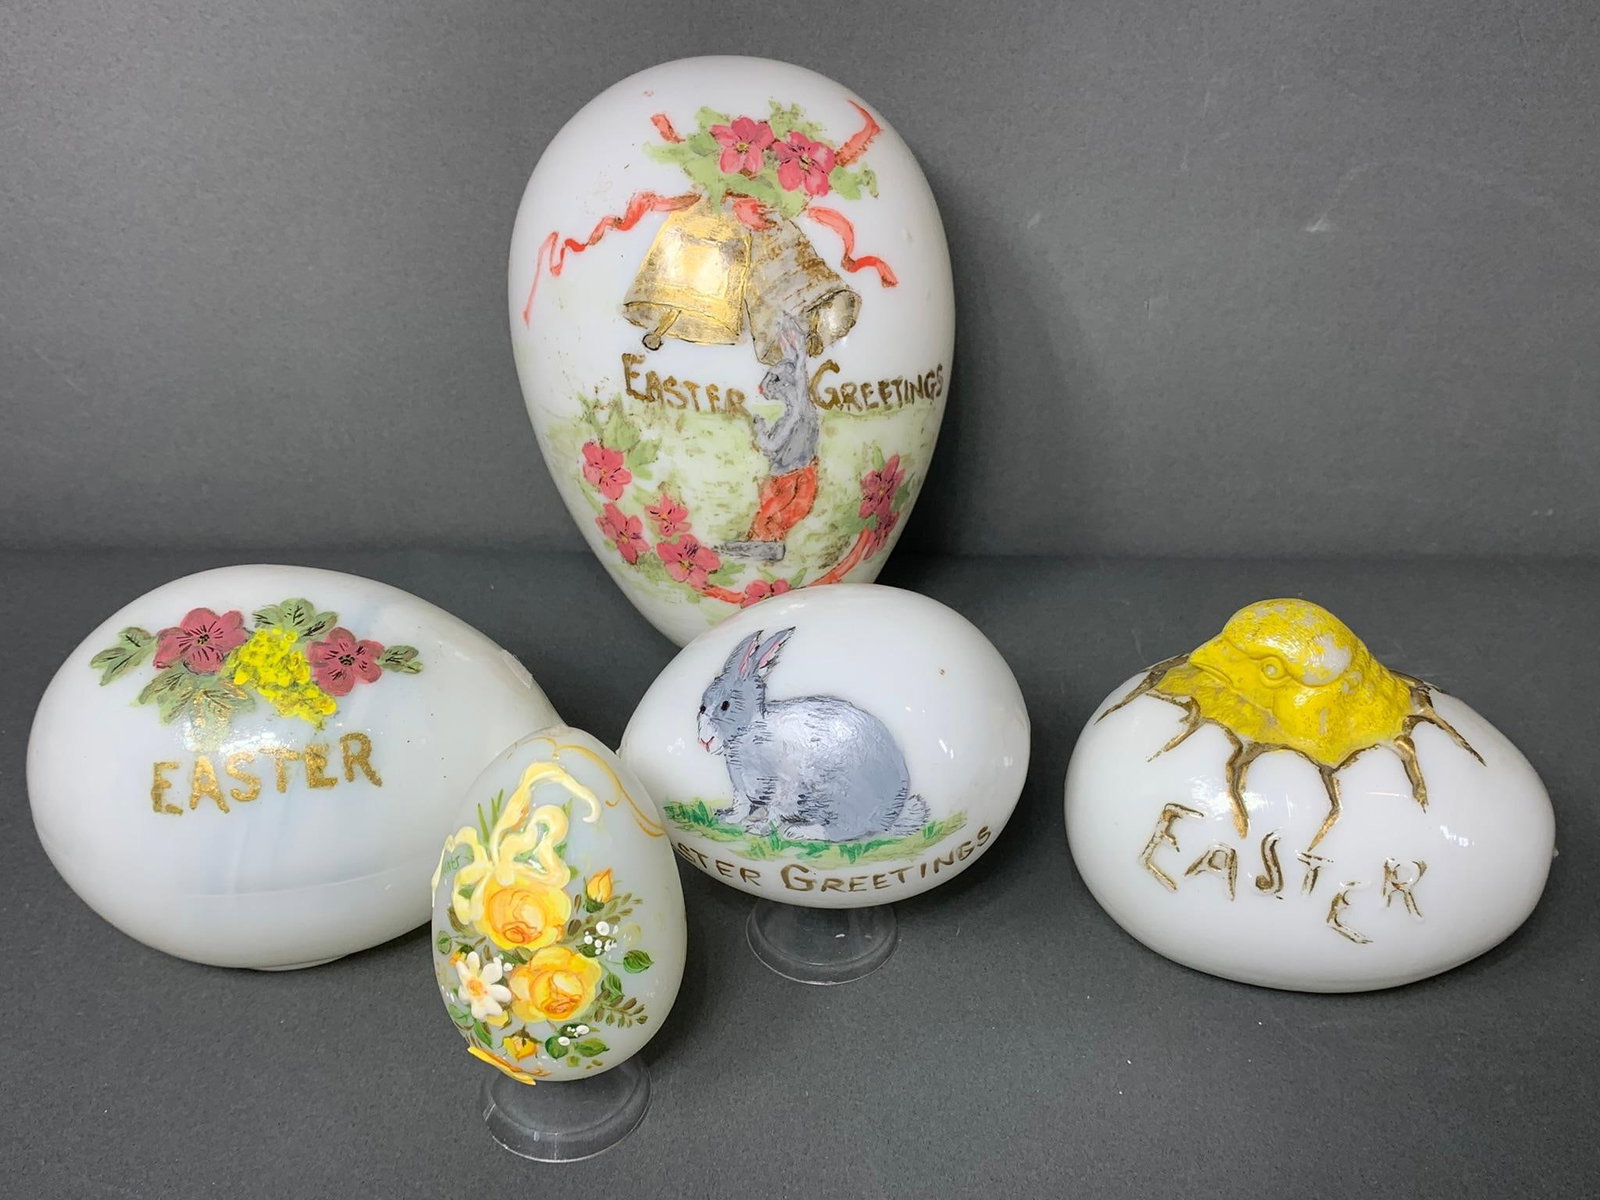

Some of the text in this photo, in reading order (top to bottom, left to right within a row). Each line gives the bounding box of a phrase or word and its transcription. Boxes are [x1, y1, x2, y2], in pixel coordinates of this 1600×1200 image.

[621, 353, 944, 416] EASTER GREETINGS
[151, 732, 383, 816] EASTER
[673, 826, 992, 893] STER GREETINGS
[1139, 802, 1428, 945] EASTER
